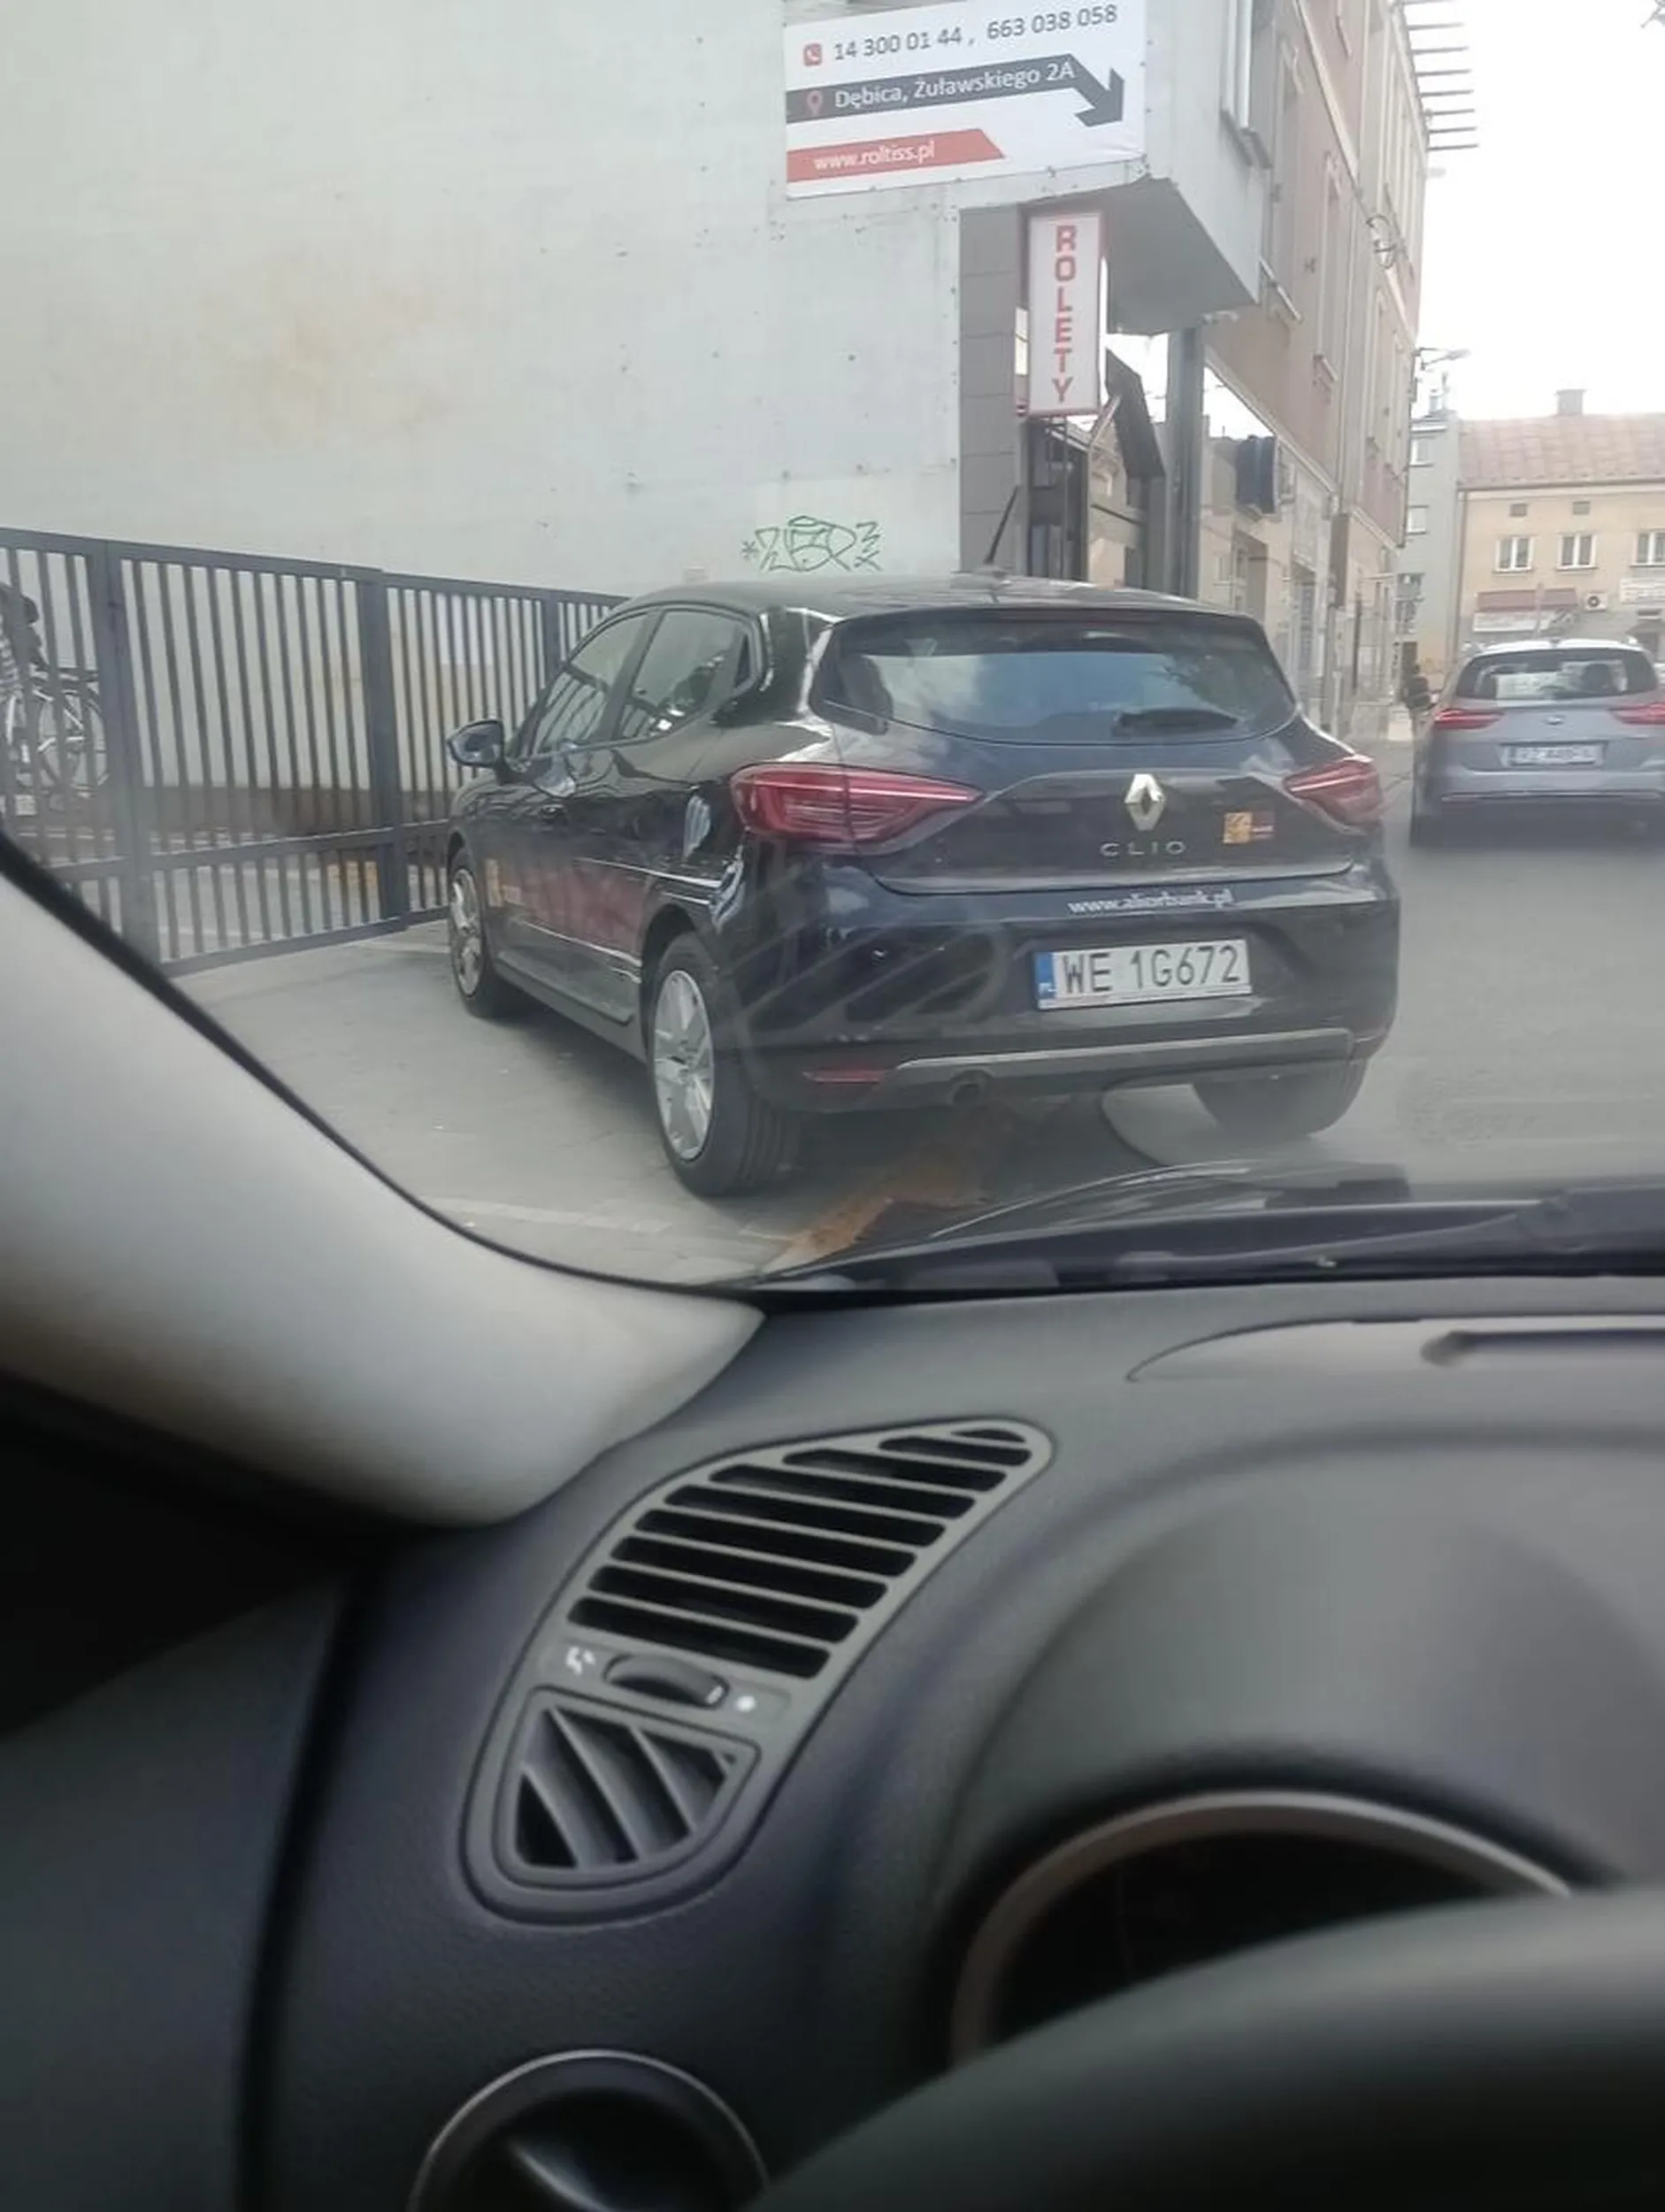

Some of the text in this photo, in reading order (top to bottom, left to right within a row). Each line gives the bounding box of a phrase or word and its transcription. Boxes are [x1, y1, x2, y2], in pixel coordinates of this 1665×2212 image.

[834, 41, 857, 61] 14
[863, 35, 901, 57] 300
[906, 32, 931, 50] 01
[986, 18, 1025, 40] 663
[1032, 11, 1071, 34] 038
[1078, 4, 1117, 27] 058
[834, 60, 1076, 109] Dębica, Żuławskiego 2A
[812, 140, 935, 171] www.roltiss.pl
[1051, 225, 1078, 403] ROLETY
[1100, 841, 1185, 856] CLIO
[1063, 945, 1240, 995] WE 1G672
